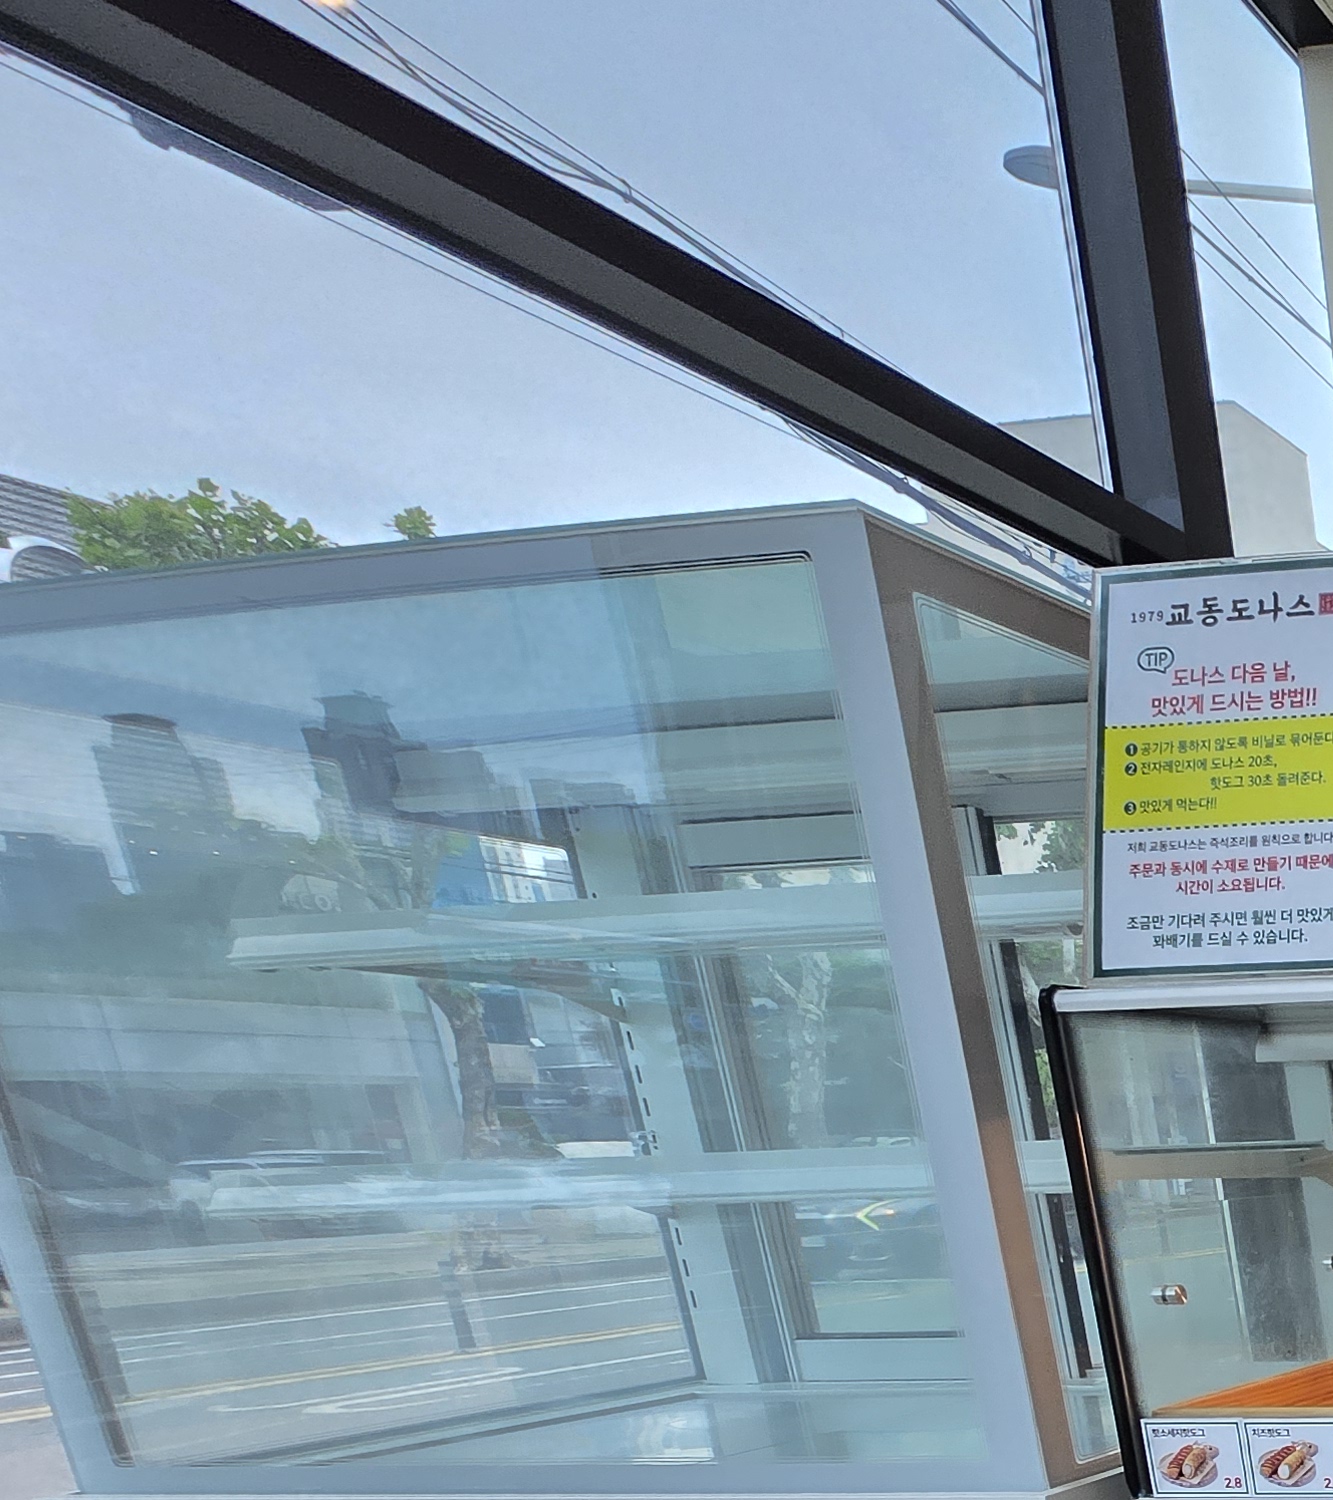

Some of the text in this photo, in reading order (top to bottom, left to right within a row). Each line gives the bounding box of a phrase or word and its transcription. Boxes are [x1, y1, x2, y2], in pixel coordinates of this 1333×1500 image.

[1131, 610, 1164, 624] 1979
[1165, 591, 1315, 627] 교동도나스
[1145, 652, 1168, 667] TIP
[1171, 660, 1295, 687] 도나스 다음 날,
[1151, 687, 1317, 717] 맛있게 드시는 방법!!
[1140, 741, 1174, 756] 공기가
[1177, 738, 1211, 753] 통하지
[1214, 736, 1248, 751] 않도록
[1252, 734, 1286, 748] 비닐로
[1140, 758, 1207, 775] 전자레인지에
[1210, 756, 1245, 771] 도나스
[1248, 754, 1277, 768] 20초,
[1210, 770, 1326, 790] 핫도그 30초 돌려준다.
[1139, 798, 1173, 814] 맛있게
[1176, 796, 1217, 812] 먹는다!!
[1127, 842, 1146, 853] 저희
[1149, 839, 1207, 852] 교동도나스는
[1209, 836, 1258, 849] 즉석조리를
[1261, 833, 1301, 847] 원칙으로
[1129, 862, 1167, 878] 주문과
[1170, 860, 1208, 876] 동시에
[1211, 858, 1250, 874] 수제로
[1253, 855, 1292, 872] 만들기
[1175, 876, 1286, 895] 시간이 소요됩니다.
[1126, 915, 1164, 931] 조금만
[1168, 913, 1206, 929] 기다려
[1209, 911, 1248, 927] 주시면
[1250, 909, 1277, 925] 훨씬
[1280, 909, 1293, 924] 더
[1152, 928, 1308, 949] 꽈배기를 드실 수 있습니다.
[1252, 1428, 1291, 1438] 치즈핫도그
[1224, 1477, 1243, 1490] 2.8
